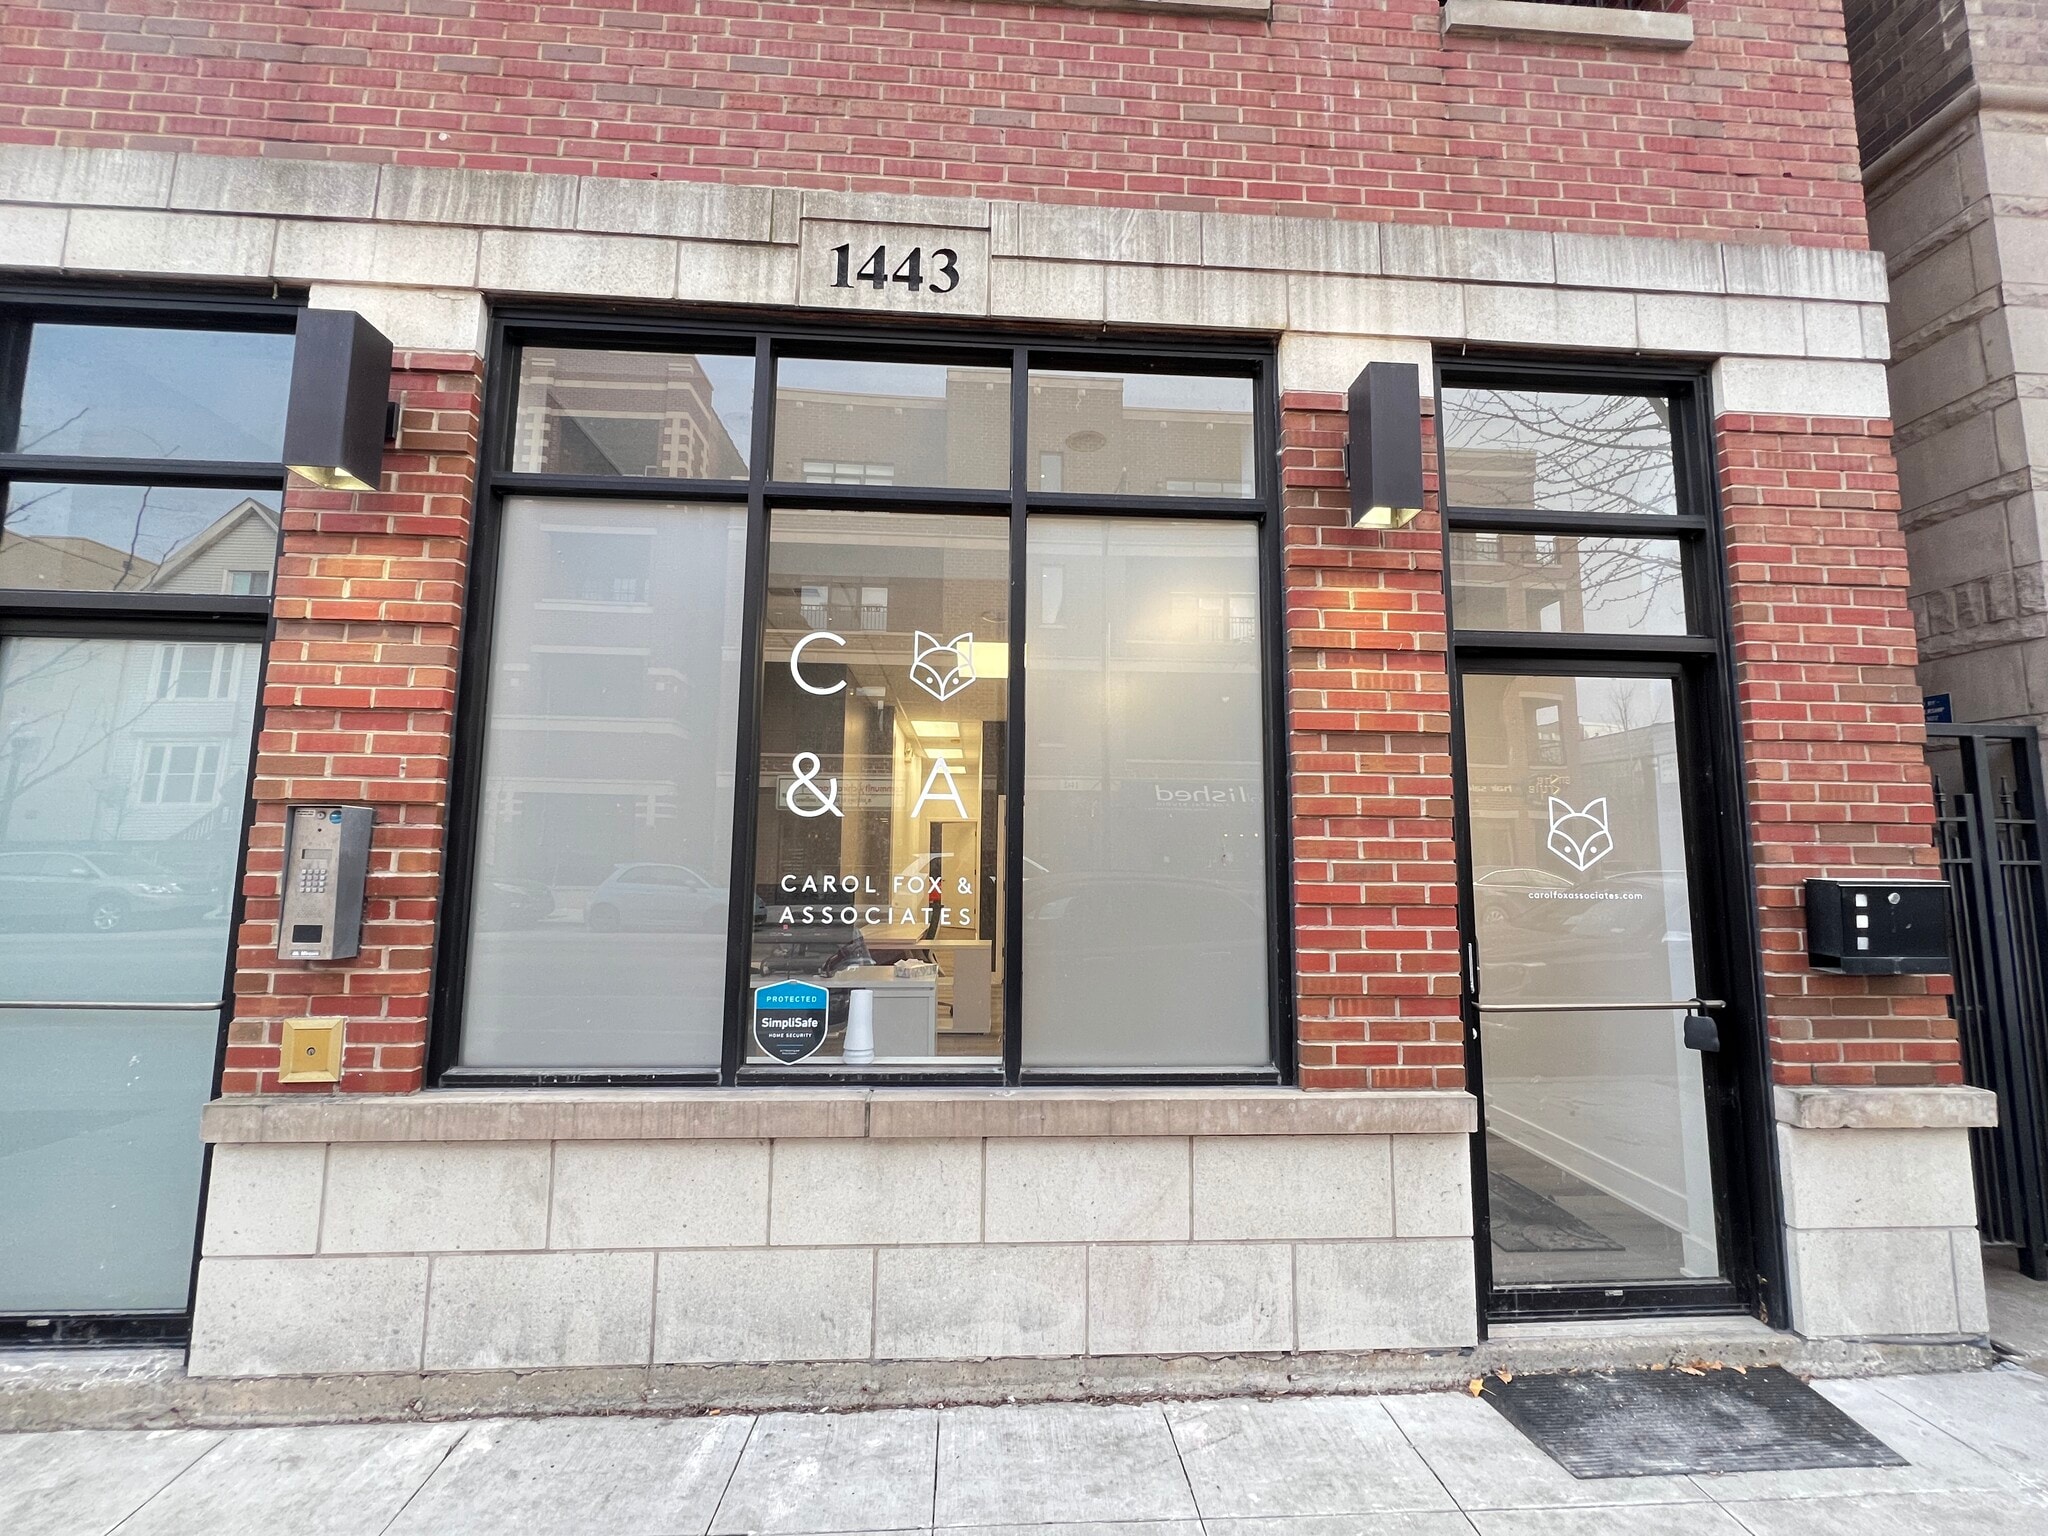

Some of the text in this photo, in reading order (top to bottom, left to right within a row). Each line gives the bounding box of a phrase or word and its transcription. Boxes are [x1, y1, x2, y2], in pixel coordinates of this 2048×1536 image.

[830, 243, 960, 293] 1443
[790, 631, 847, 695] C
[786, 752, 968, 819] & A
[781, 875, 973, 894] CAROL FOX &
[1528, 891, 1643, 900] carolfoxassociates.com
[779, 906, 971, 925] ASSOCIATES
[761, 1017, 818, 1030] SimpliSafe
